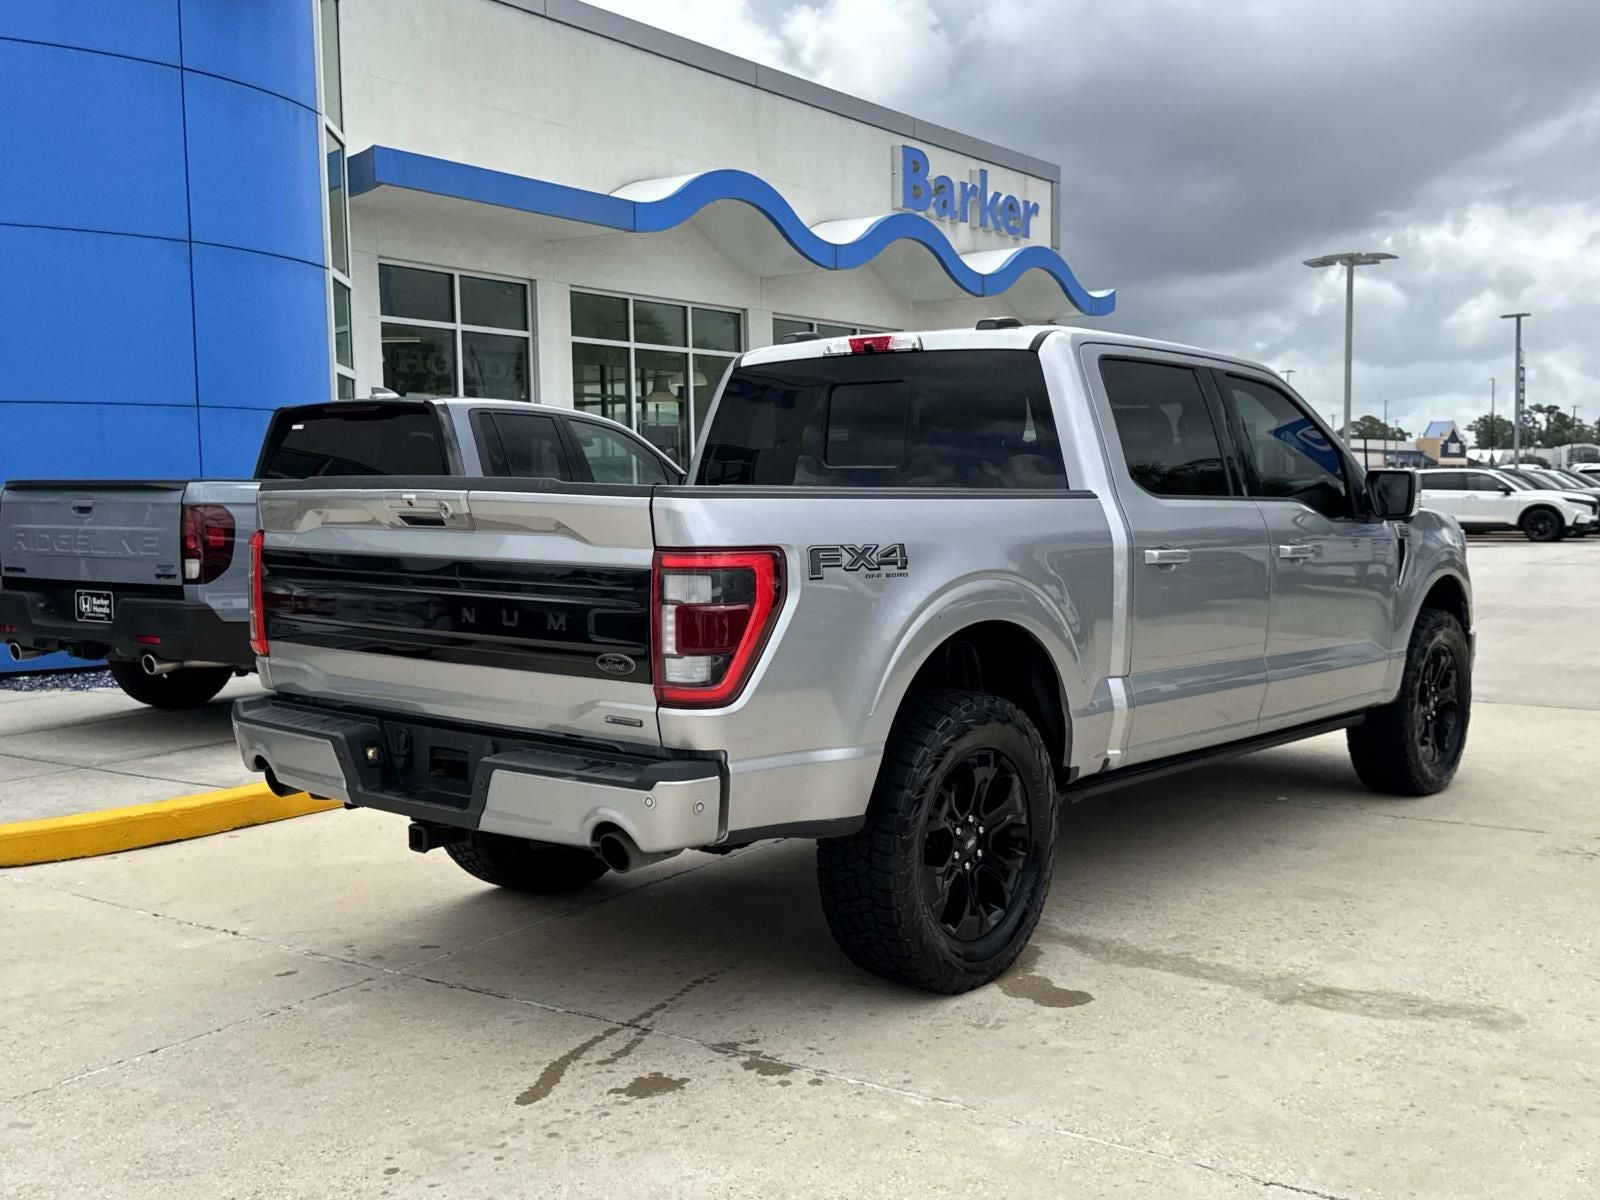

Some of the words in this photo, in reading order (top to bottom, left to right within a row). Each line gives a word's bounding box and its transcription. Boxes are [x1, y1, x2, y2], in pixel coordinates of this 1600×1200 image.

[901, 145, 1040, 239] Barker
[807, 543, 908, 580] FX4
[92, 597, 110, 606] Barker
[92, 605, 111, 614] Honda
